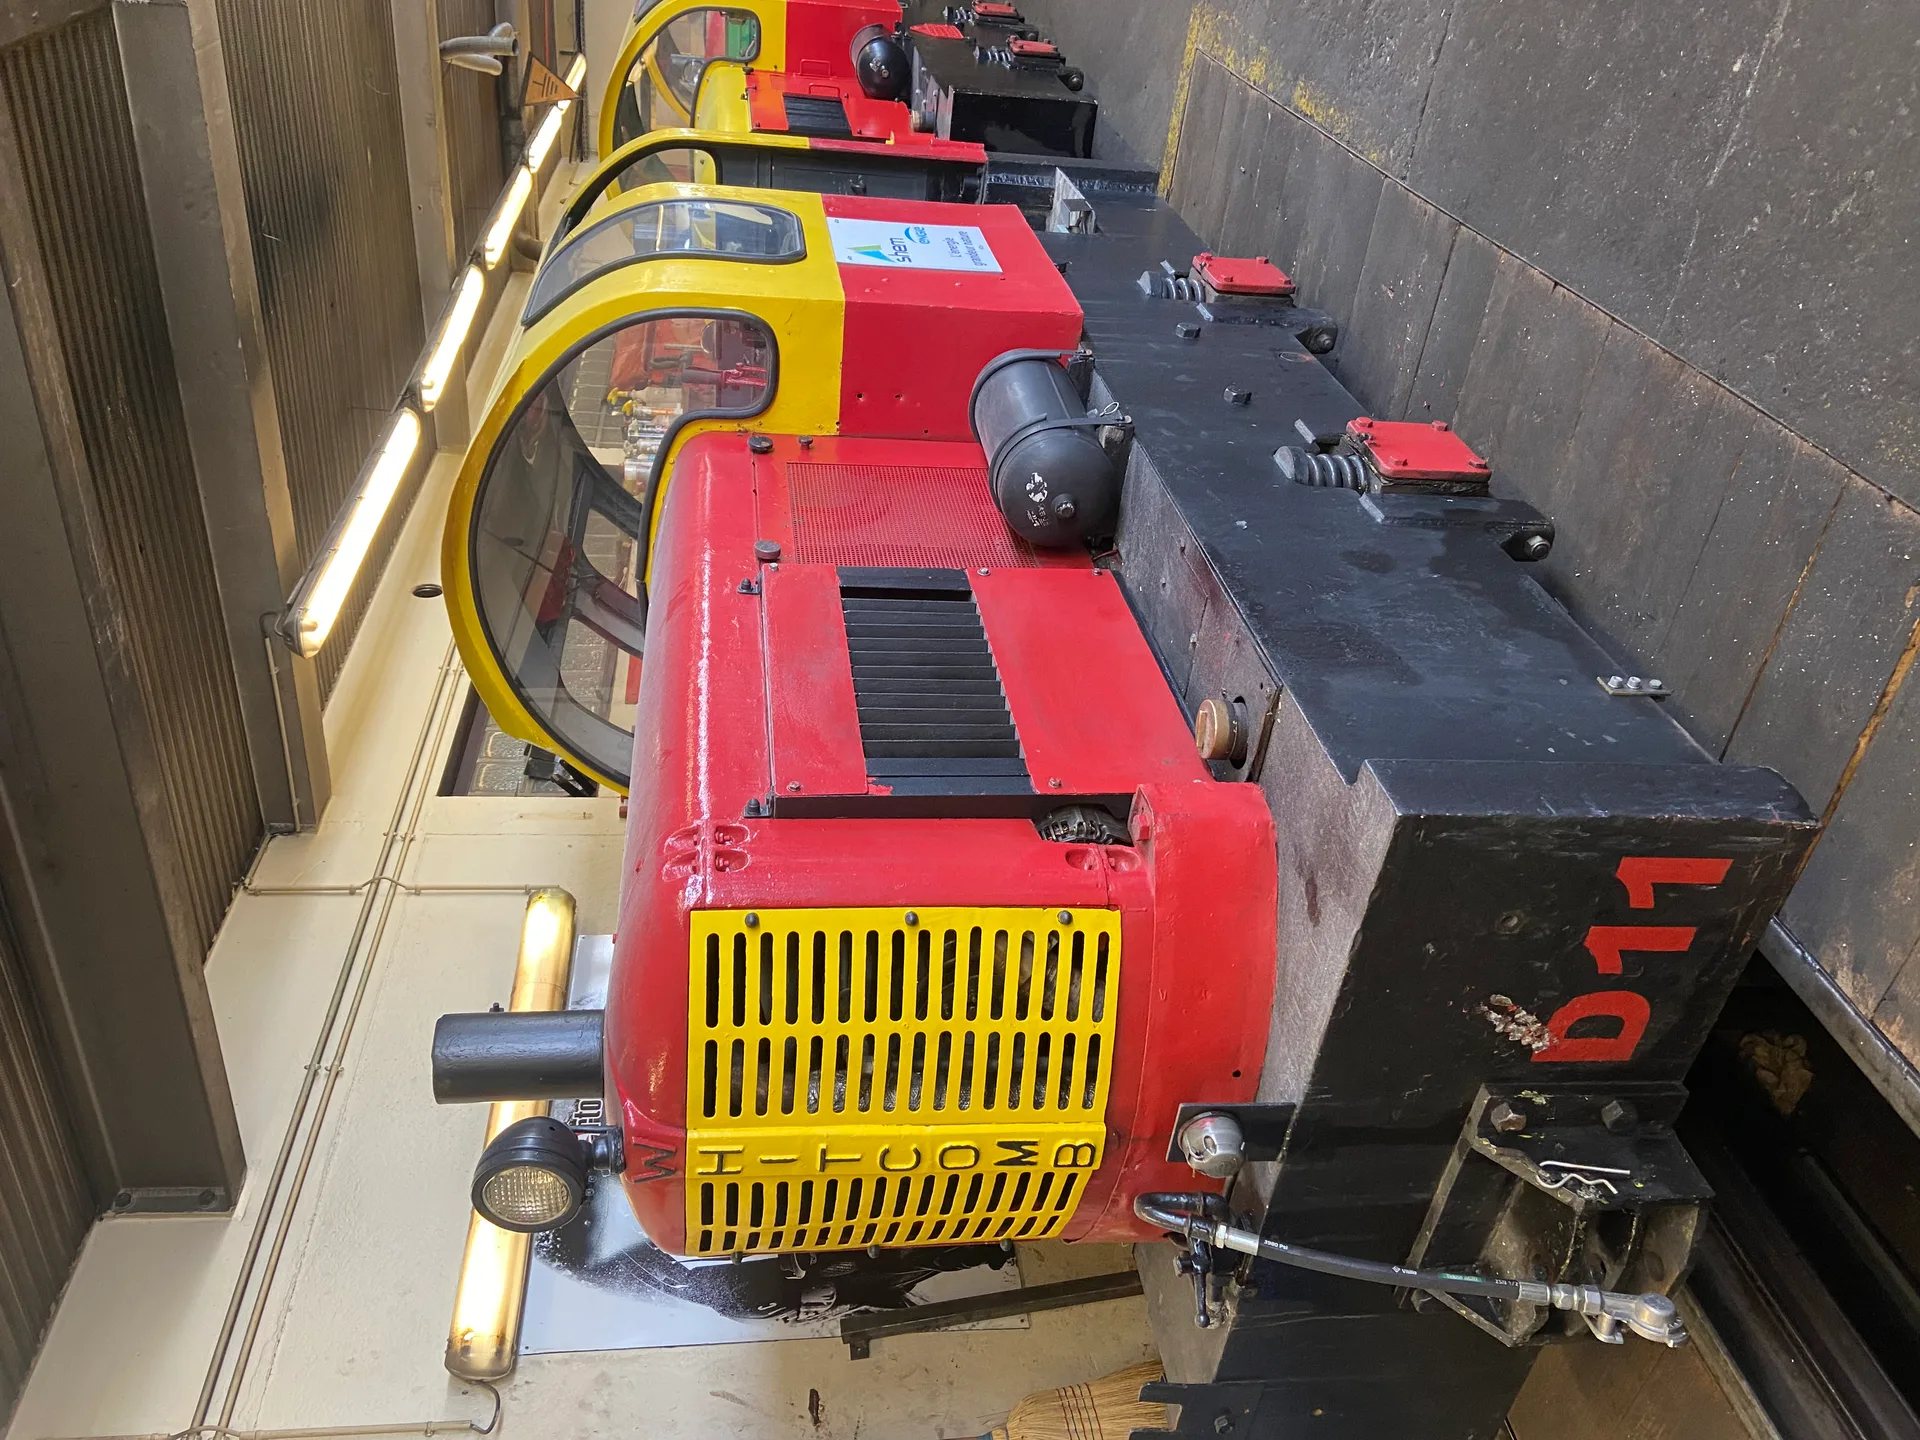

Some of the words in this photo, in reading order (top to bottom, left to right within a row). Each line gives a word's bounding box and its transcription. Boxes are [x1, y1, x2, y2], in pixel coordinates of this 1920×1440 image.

[888, 237, 912, 263] shem
[1530, 856, 1734, 1063] D11
[631, 1136, 1096, 1184] WHITCOMB
